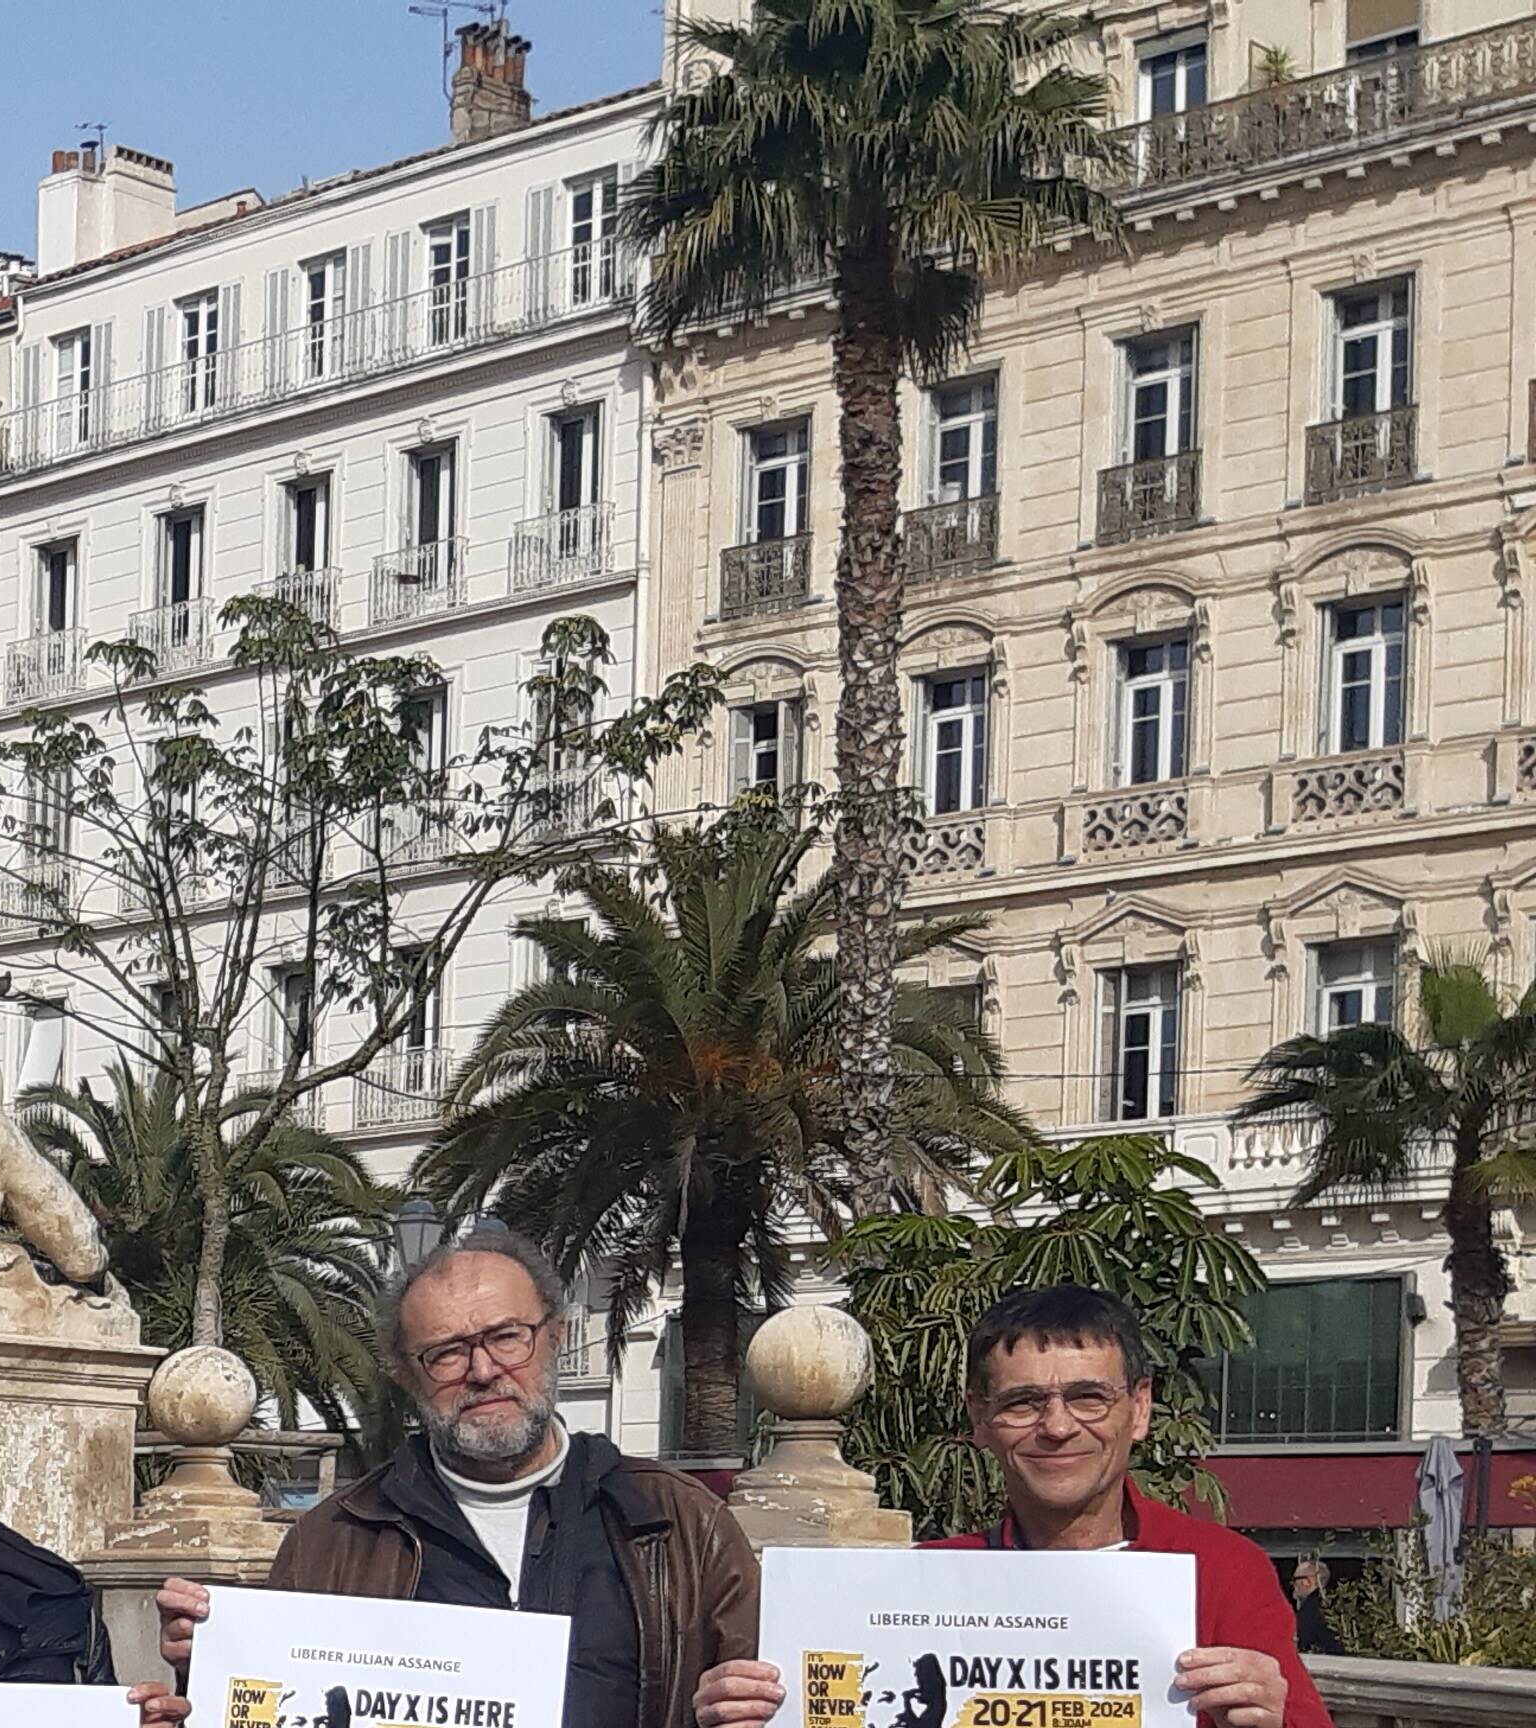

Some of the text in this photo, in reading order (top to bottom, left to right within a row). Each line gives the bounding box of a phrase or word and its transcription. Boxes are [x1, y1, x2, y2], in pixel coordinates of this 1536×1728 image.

[870, 1613, 1068, 1629] LIBERER JULIAN ASSANGE
[808, 1664, 846, 1680] NOW
[950, 1656, 1140, 1690] DAY X IS HERE
[808, 1681, 829, 1697] OR
[354, 1689, 516, 1728] DAY X IS HERE
[808, 1699, 855, 1716] NEVER
[973, 1699, 1135, 1727] 20-21 FEB 2024
[809, 1717, 831, 1725] STOP
